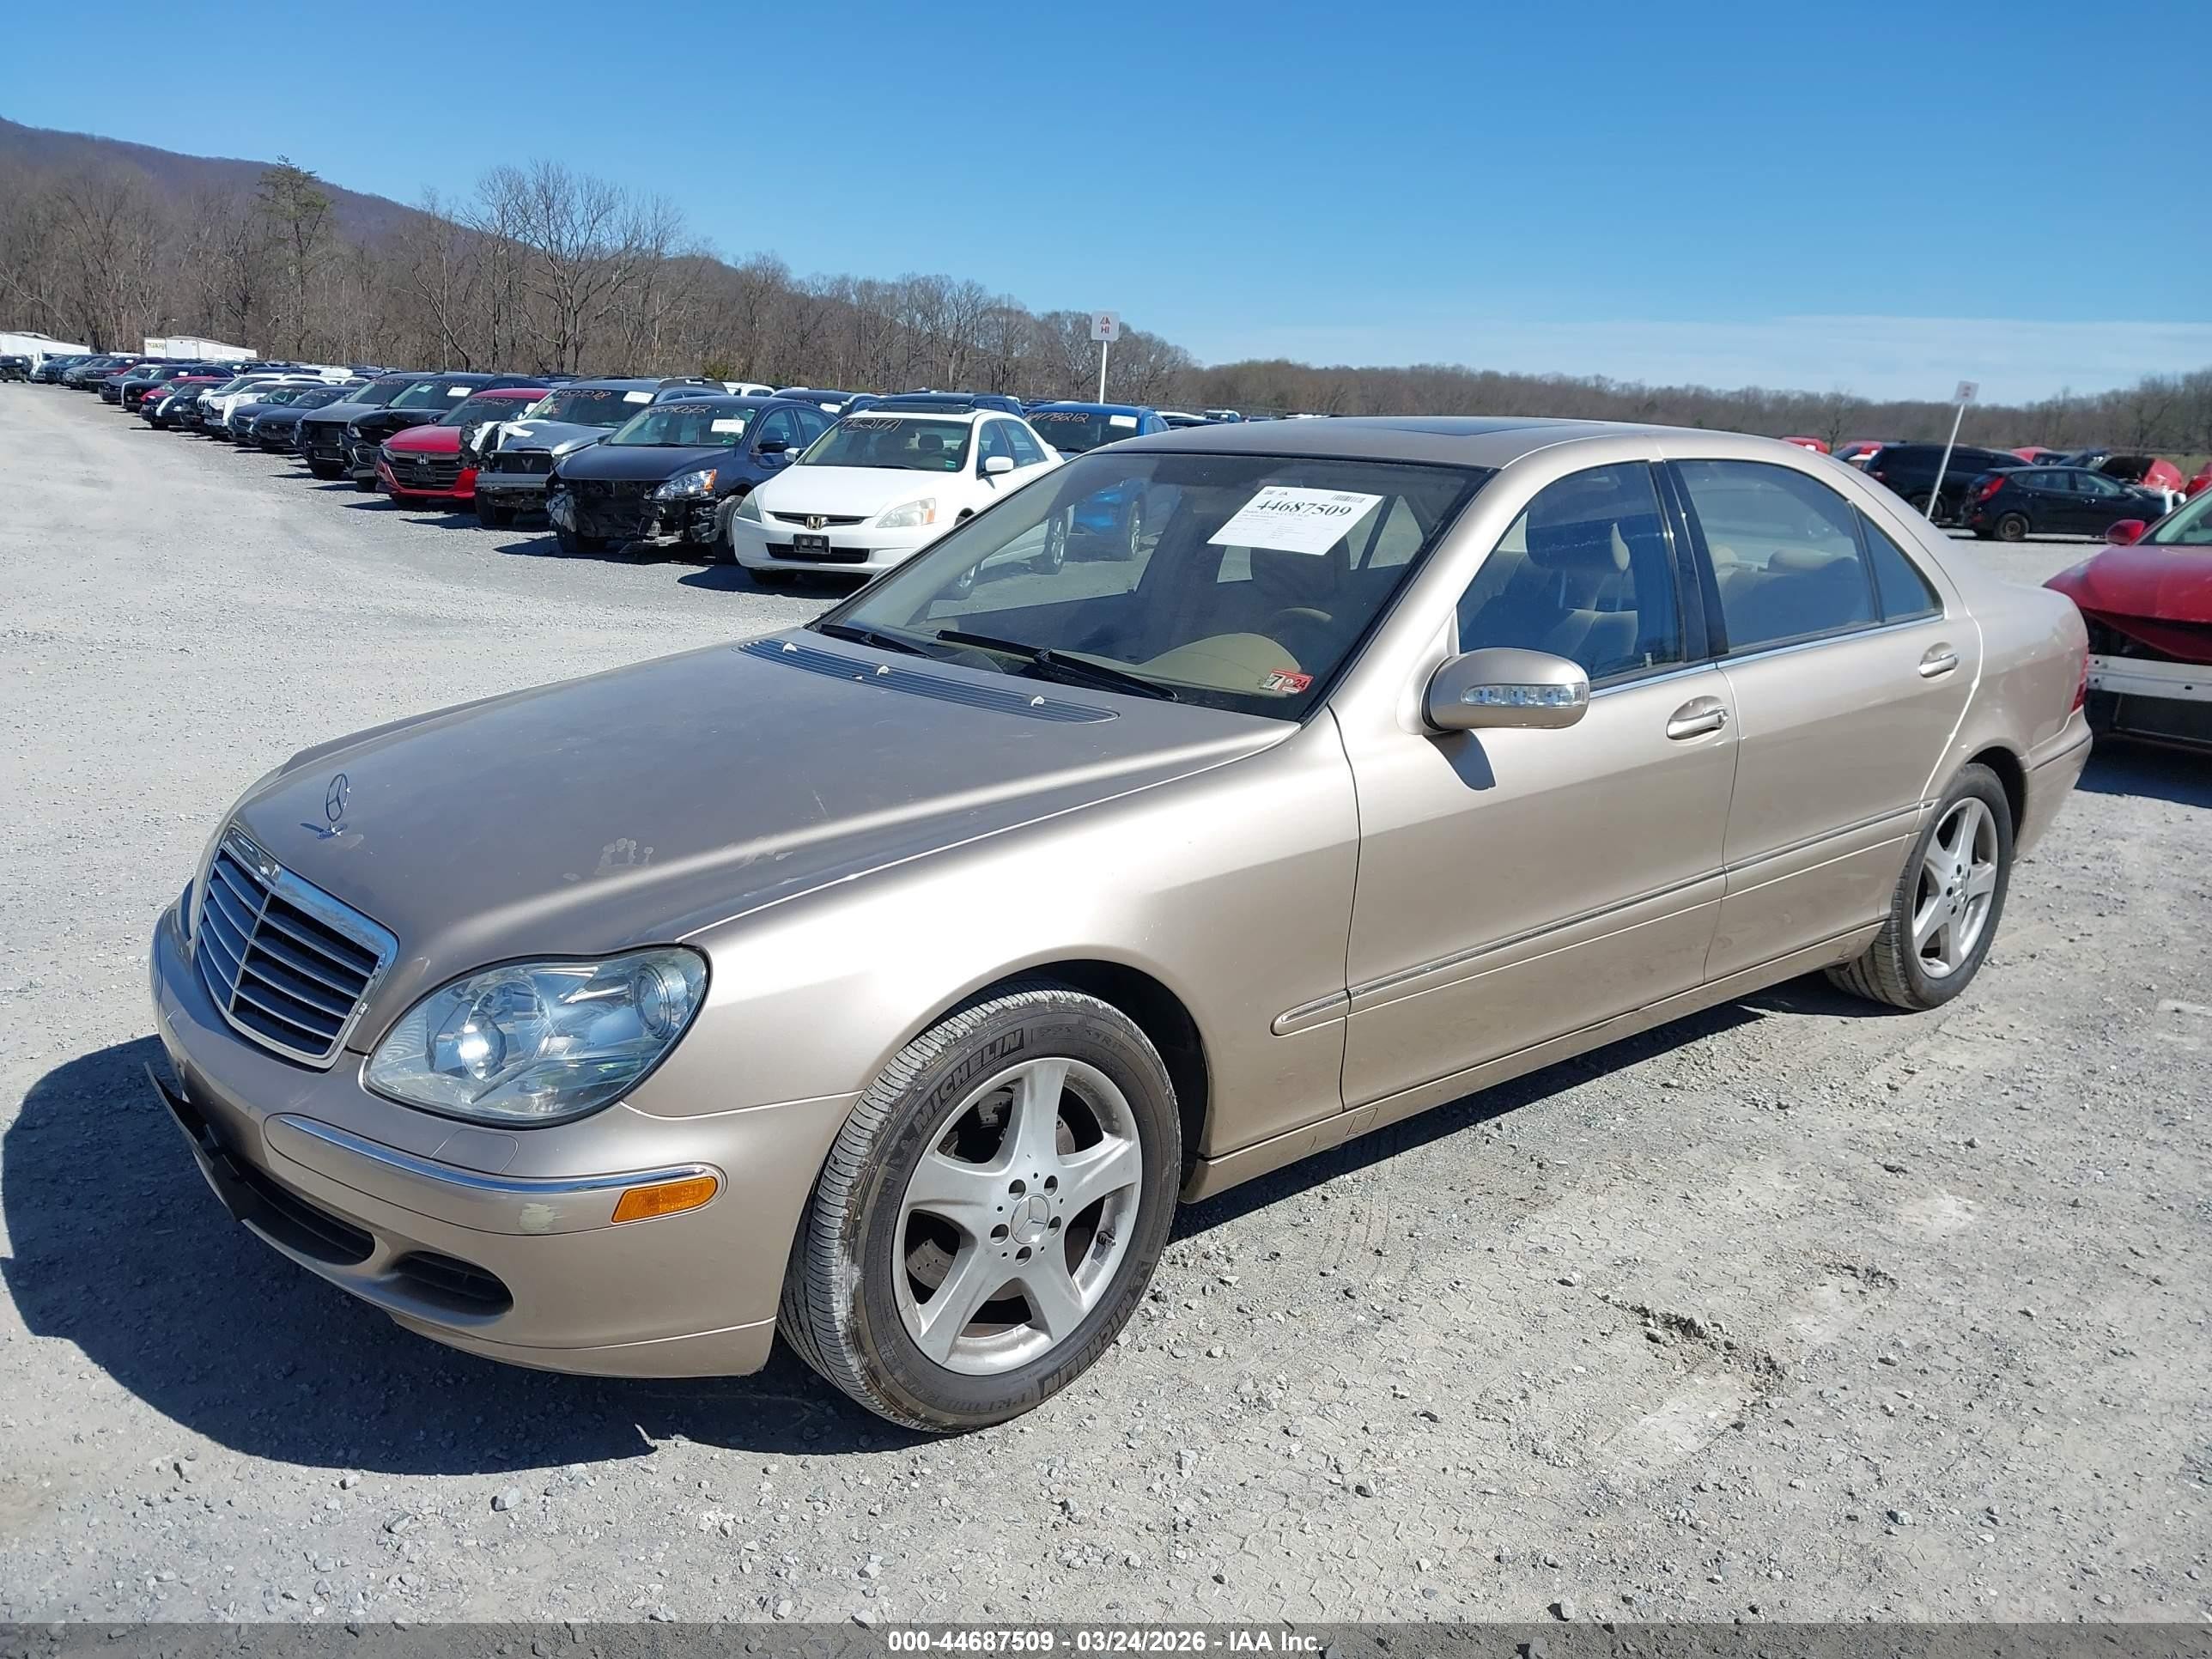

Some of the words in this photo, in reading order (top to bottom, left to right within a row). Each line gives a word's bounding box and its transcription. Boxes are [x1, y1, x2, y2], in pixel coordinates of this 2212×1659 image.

[1256, 500, 1352, 517] 44687509
[1270, 675, 1284, 687] 7
[1292, 678, 1308, 689] 24
[913, 1028, 1024, 1135] MICHELIN
[1042, 1291, 1135, 1398] MICHELIN
